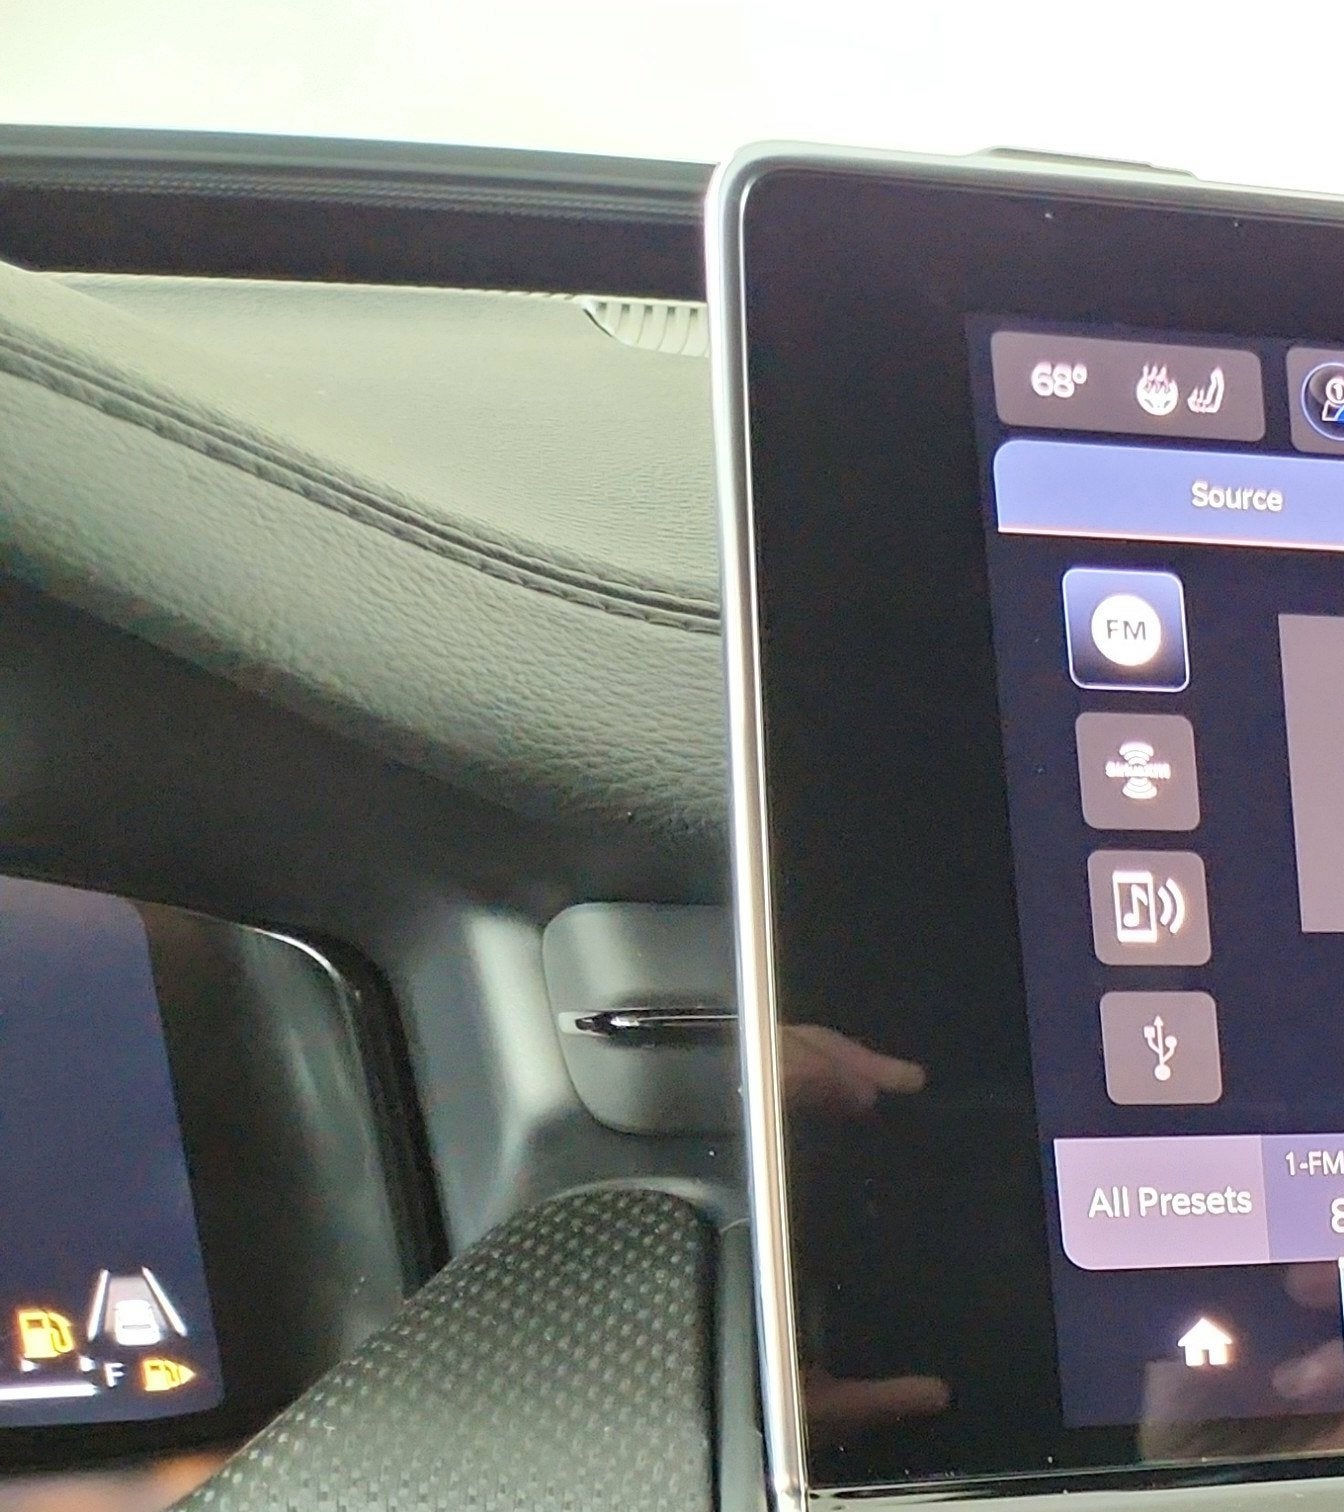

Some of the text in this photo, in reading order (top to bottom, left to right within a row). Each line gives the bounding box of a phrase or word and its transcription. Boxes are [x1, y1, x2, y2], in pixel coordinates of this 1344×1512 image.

[1191, 481, 1284, 513] Source
[1106, 620, 1148, 642] FM
[1088, 1187, 1252, 1219] All Presets
[103, 1363, 124, 1387] F
